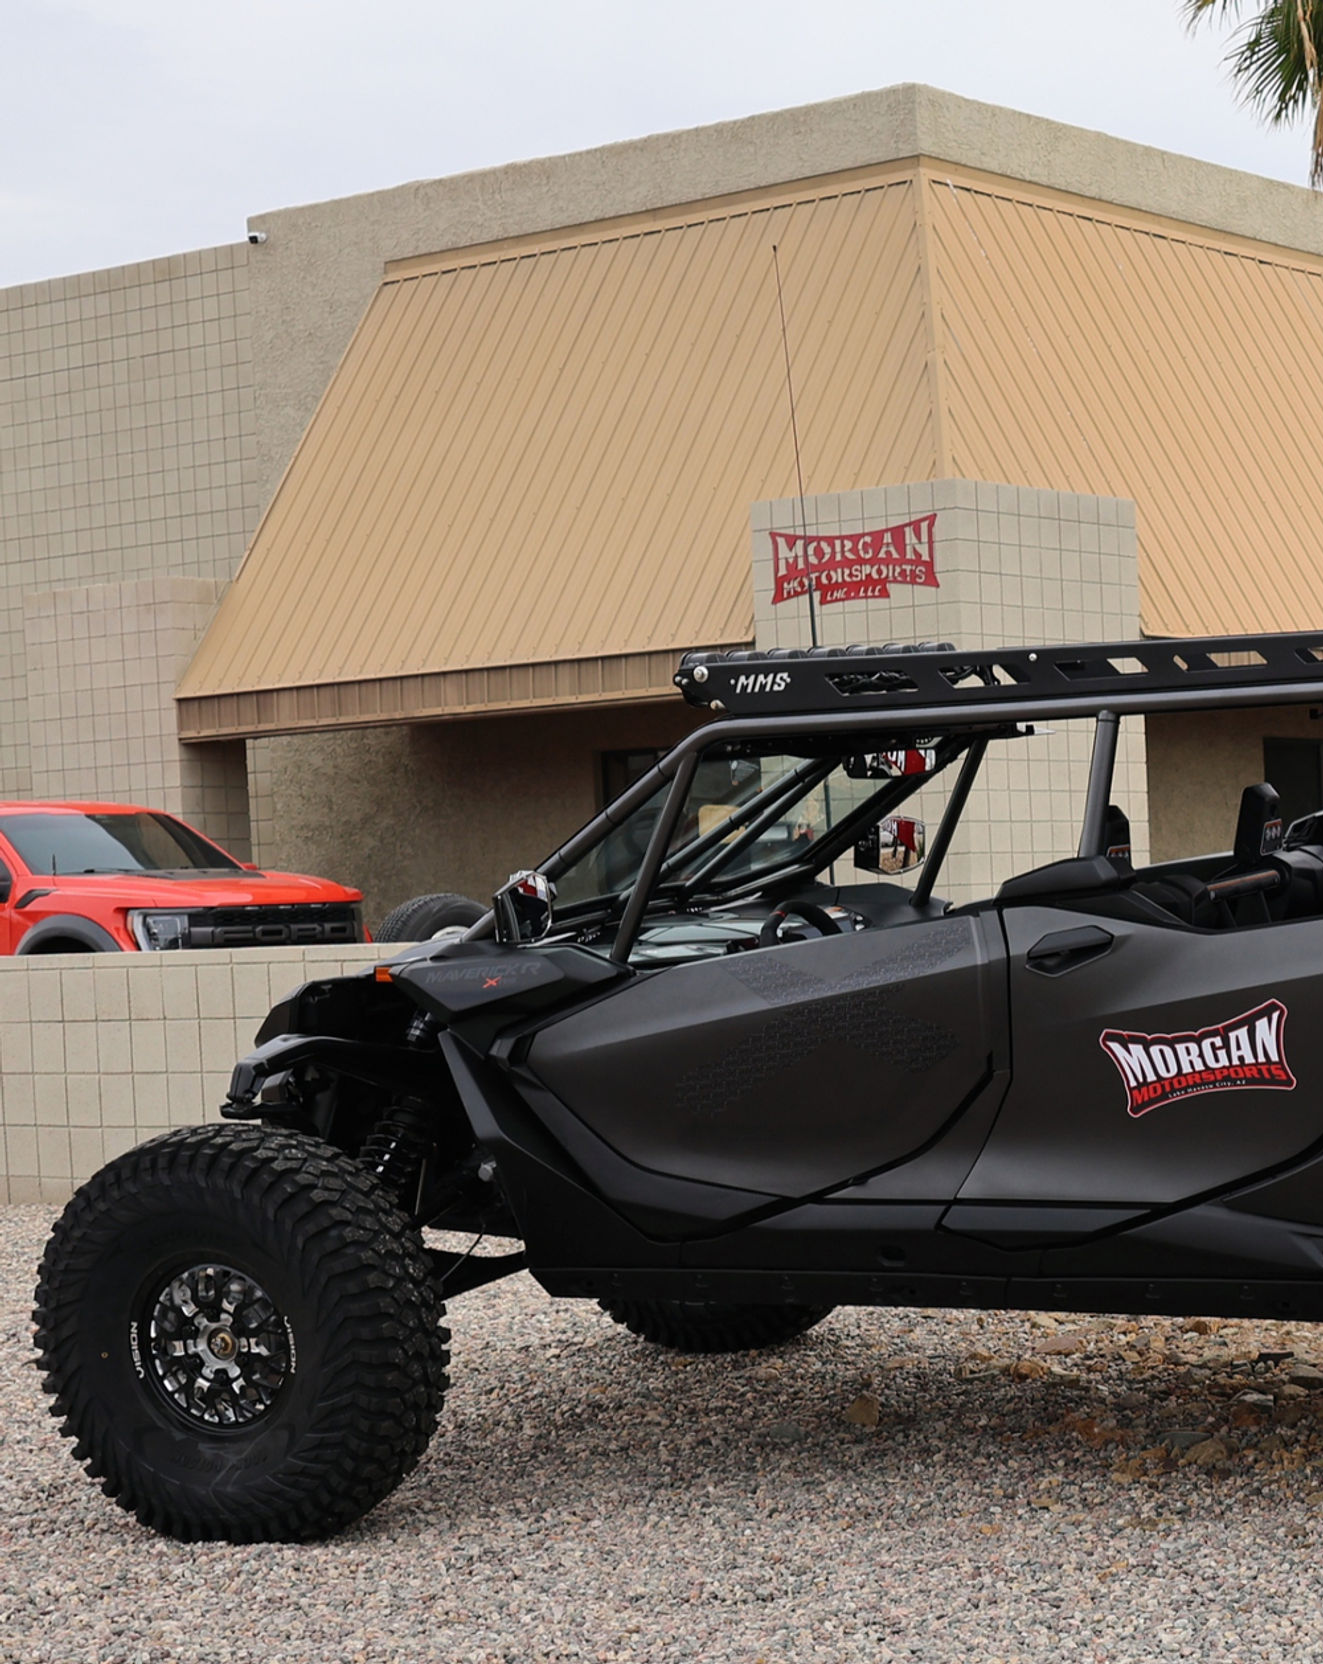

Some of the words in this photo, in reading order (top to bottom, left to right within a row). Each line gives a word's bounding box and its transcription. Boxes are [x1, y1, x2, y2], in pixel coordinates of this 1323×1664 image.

[775, 520, 931, 577] MORGAN
[782, 565, 926, 598] MOTORSPORTS
[214, 922, 353, 943] FORD
[425, 963, 518, 984] MAVERICK
[1106, 1010, 1281, 1087] MORGAN
[1132, 1064, 1287, 1106] MOTORSPORTS
[129, 1321, 145, 1379] VISION
[282, 1315, 296, 1374] VISION
